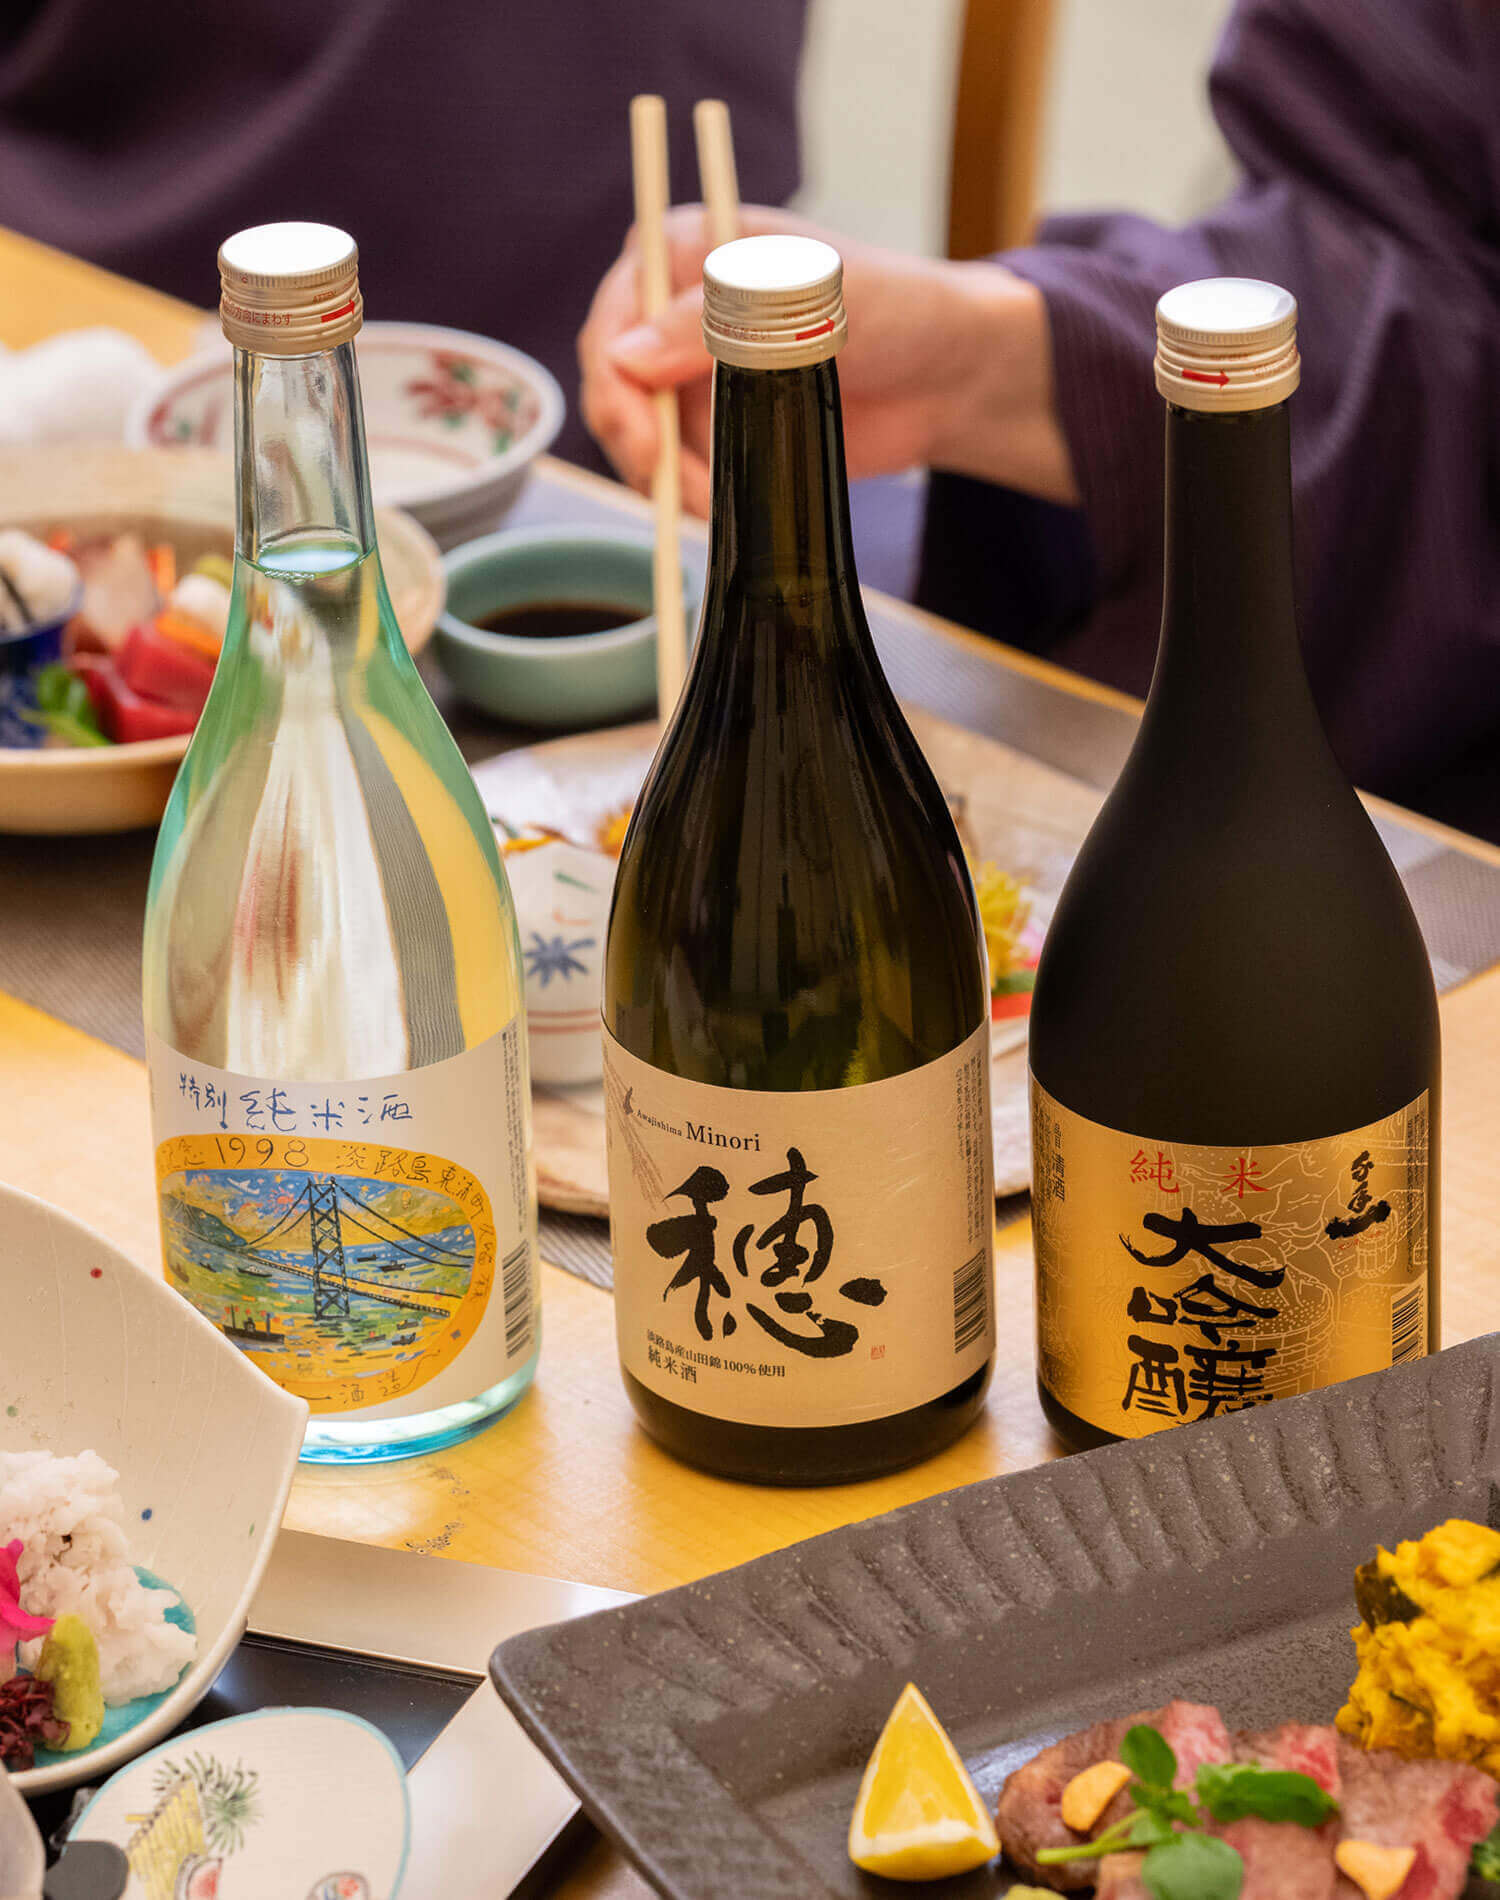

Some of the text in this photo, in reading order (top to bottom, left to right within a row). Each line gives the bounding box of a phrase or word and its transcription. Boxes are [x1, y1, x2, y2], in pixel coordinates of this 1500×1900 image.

[636, 1109, 761, 1152] Awajishima Minori
[215, 1137, 309, 1168] 1998
[648, 1345, 697, 1384] 純米酒
